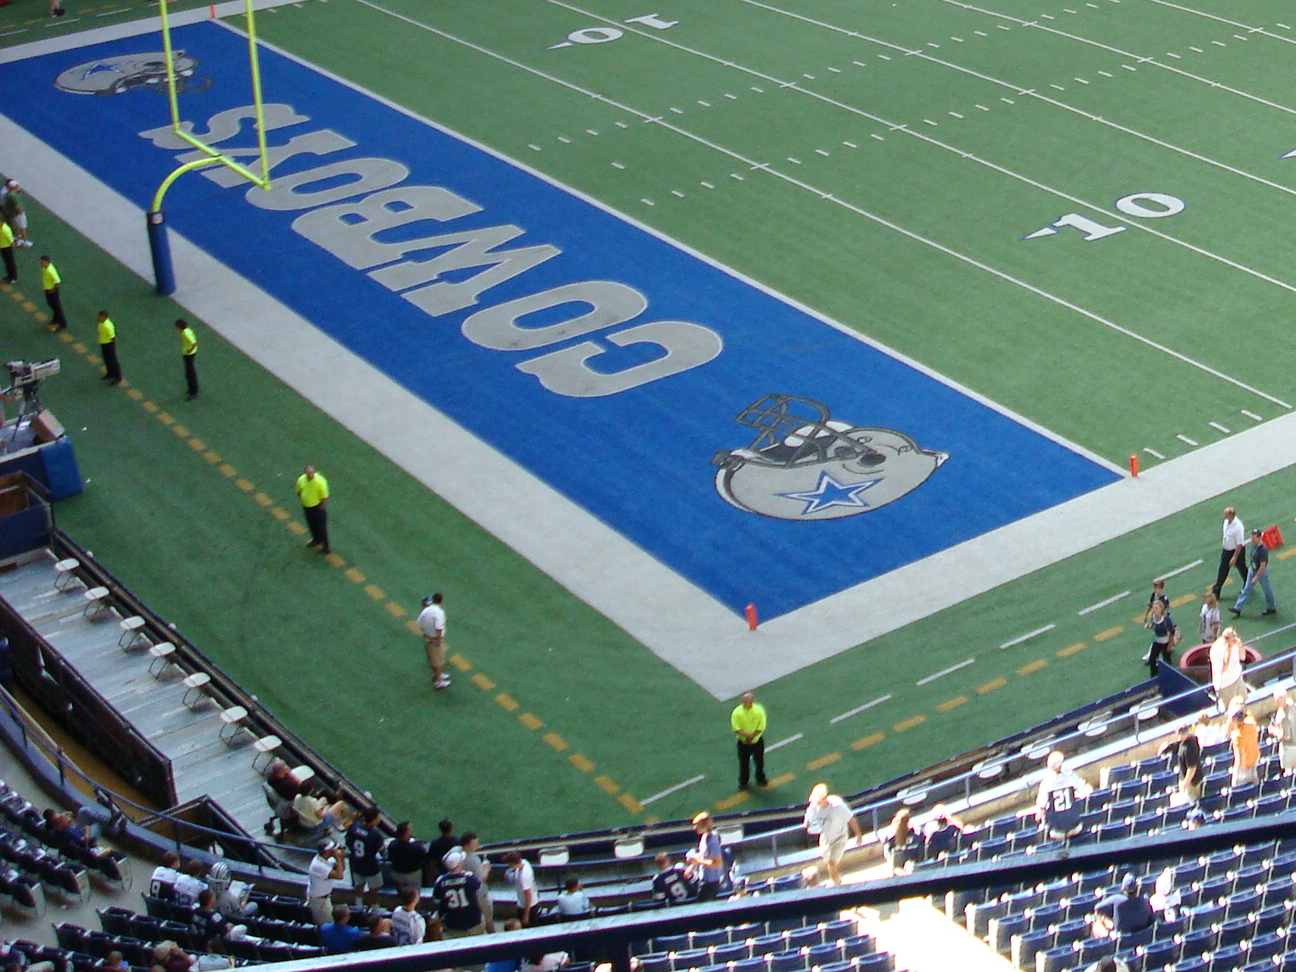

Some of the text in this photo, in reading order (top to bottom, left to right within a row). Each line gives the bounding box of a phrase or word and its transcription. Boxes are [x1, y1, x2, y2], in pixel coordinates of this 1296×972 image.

[566, 12, 680, 46] 10
[1050, 191, 1186, 242] 10
[138, 103, 724, 398] COWBOYS
[1052, 788, 1073, 812] 21
[444, 888, 470, 909] 31
